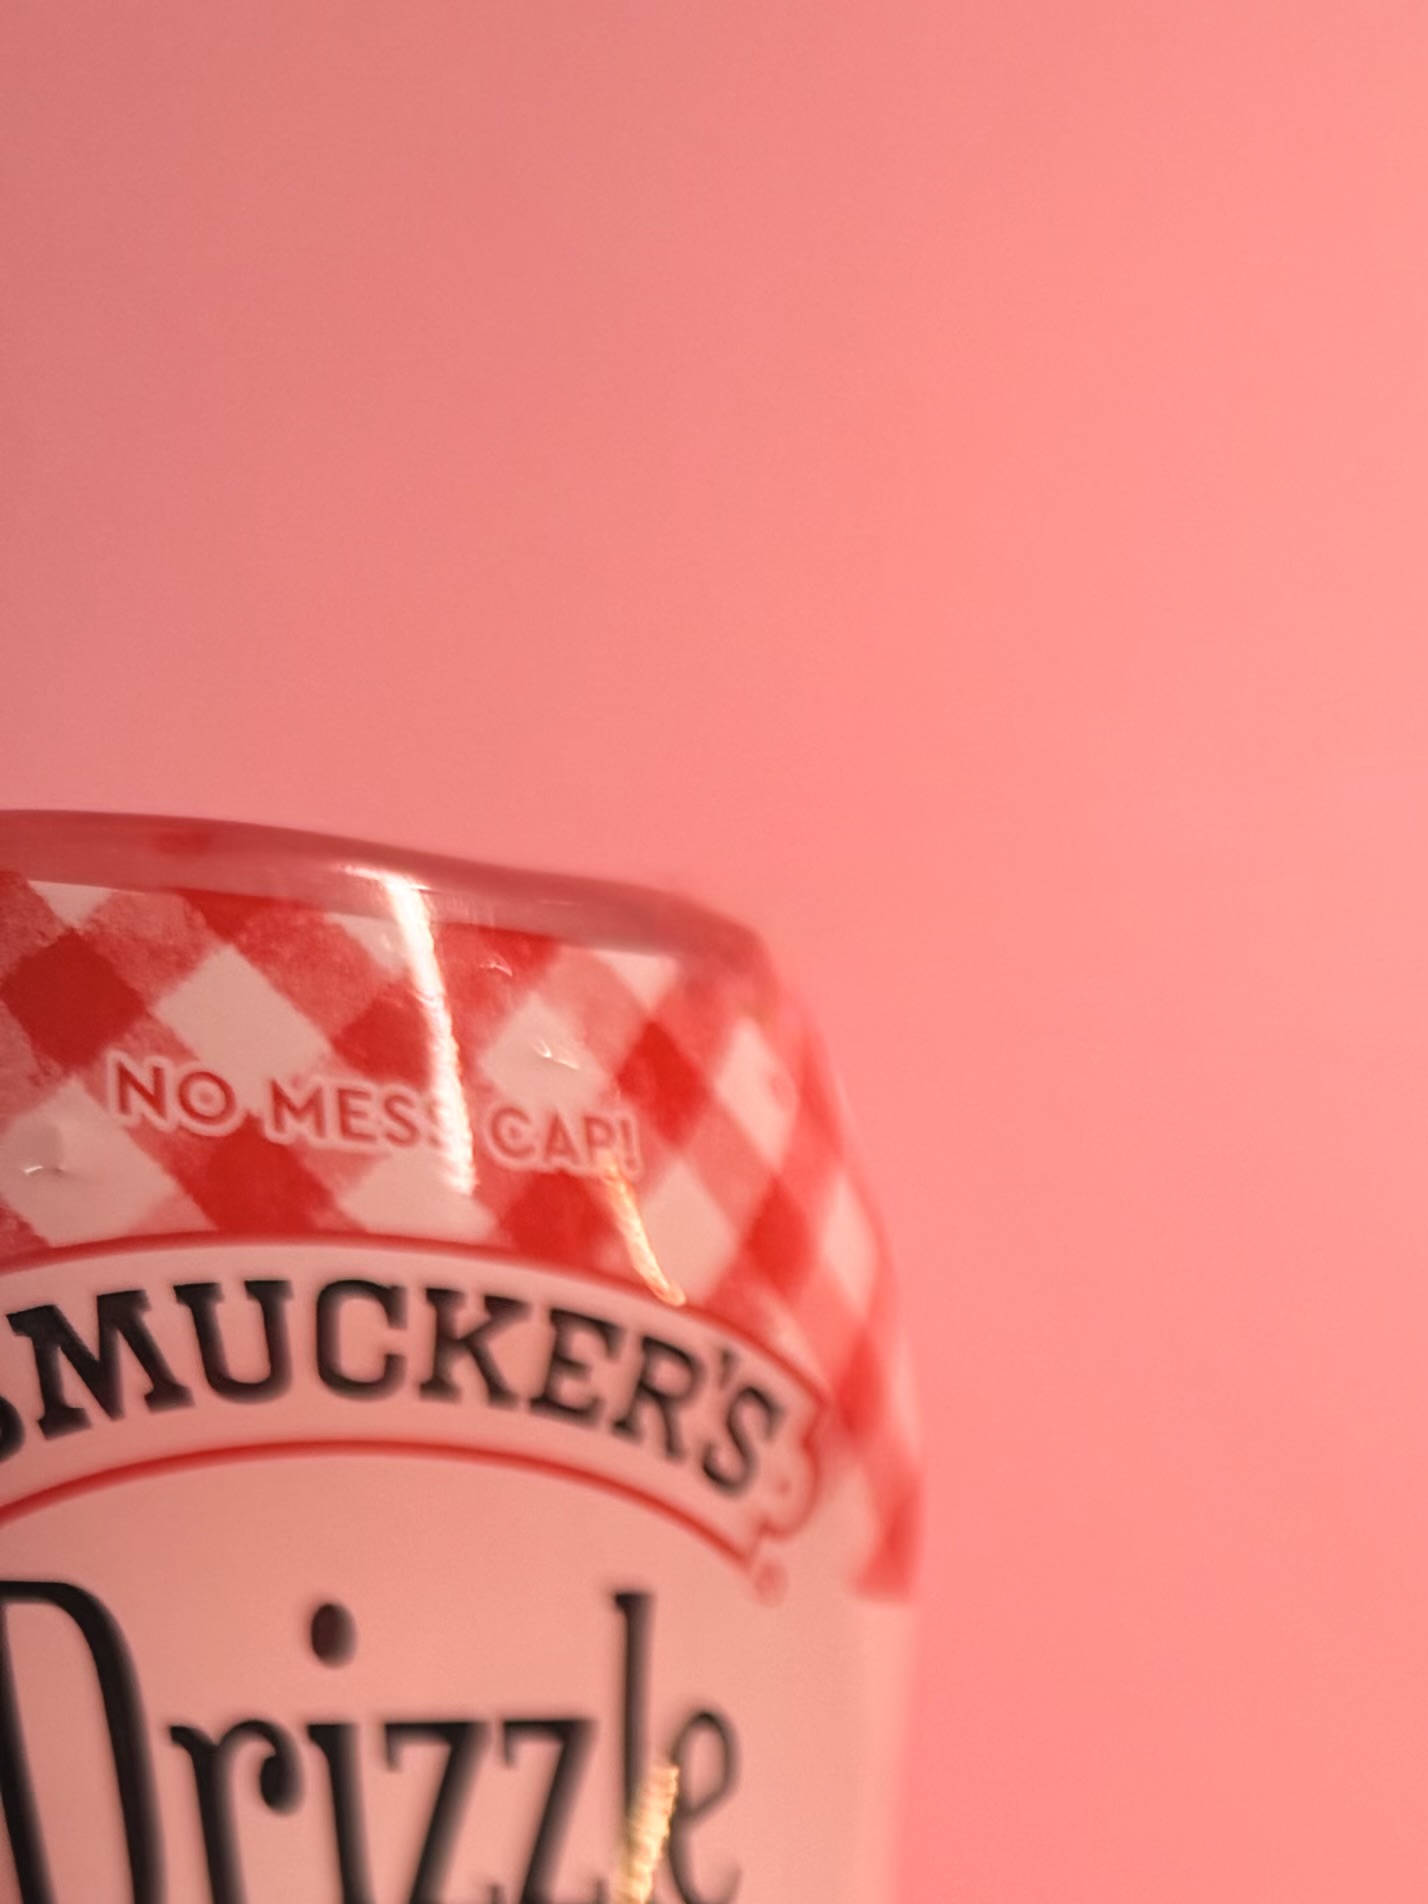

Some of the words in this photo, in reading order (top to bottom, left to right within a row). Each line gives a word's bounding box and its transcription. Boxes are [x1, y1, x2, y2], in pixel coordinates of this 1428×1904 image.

[115, 1054, 236, 1124] NO
[270, 1076, 448, 1151] MES
[0, 1277, 787, 1499] MUCKER'S
